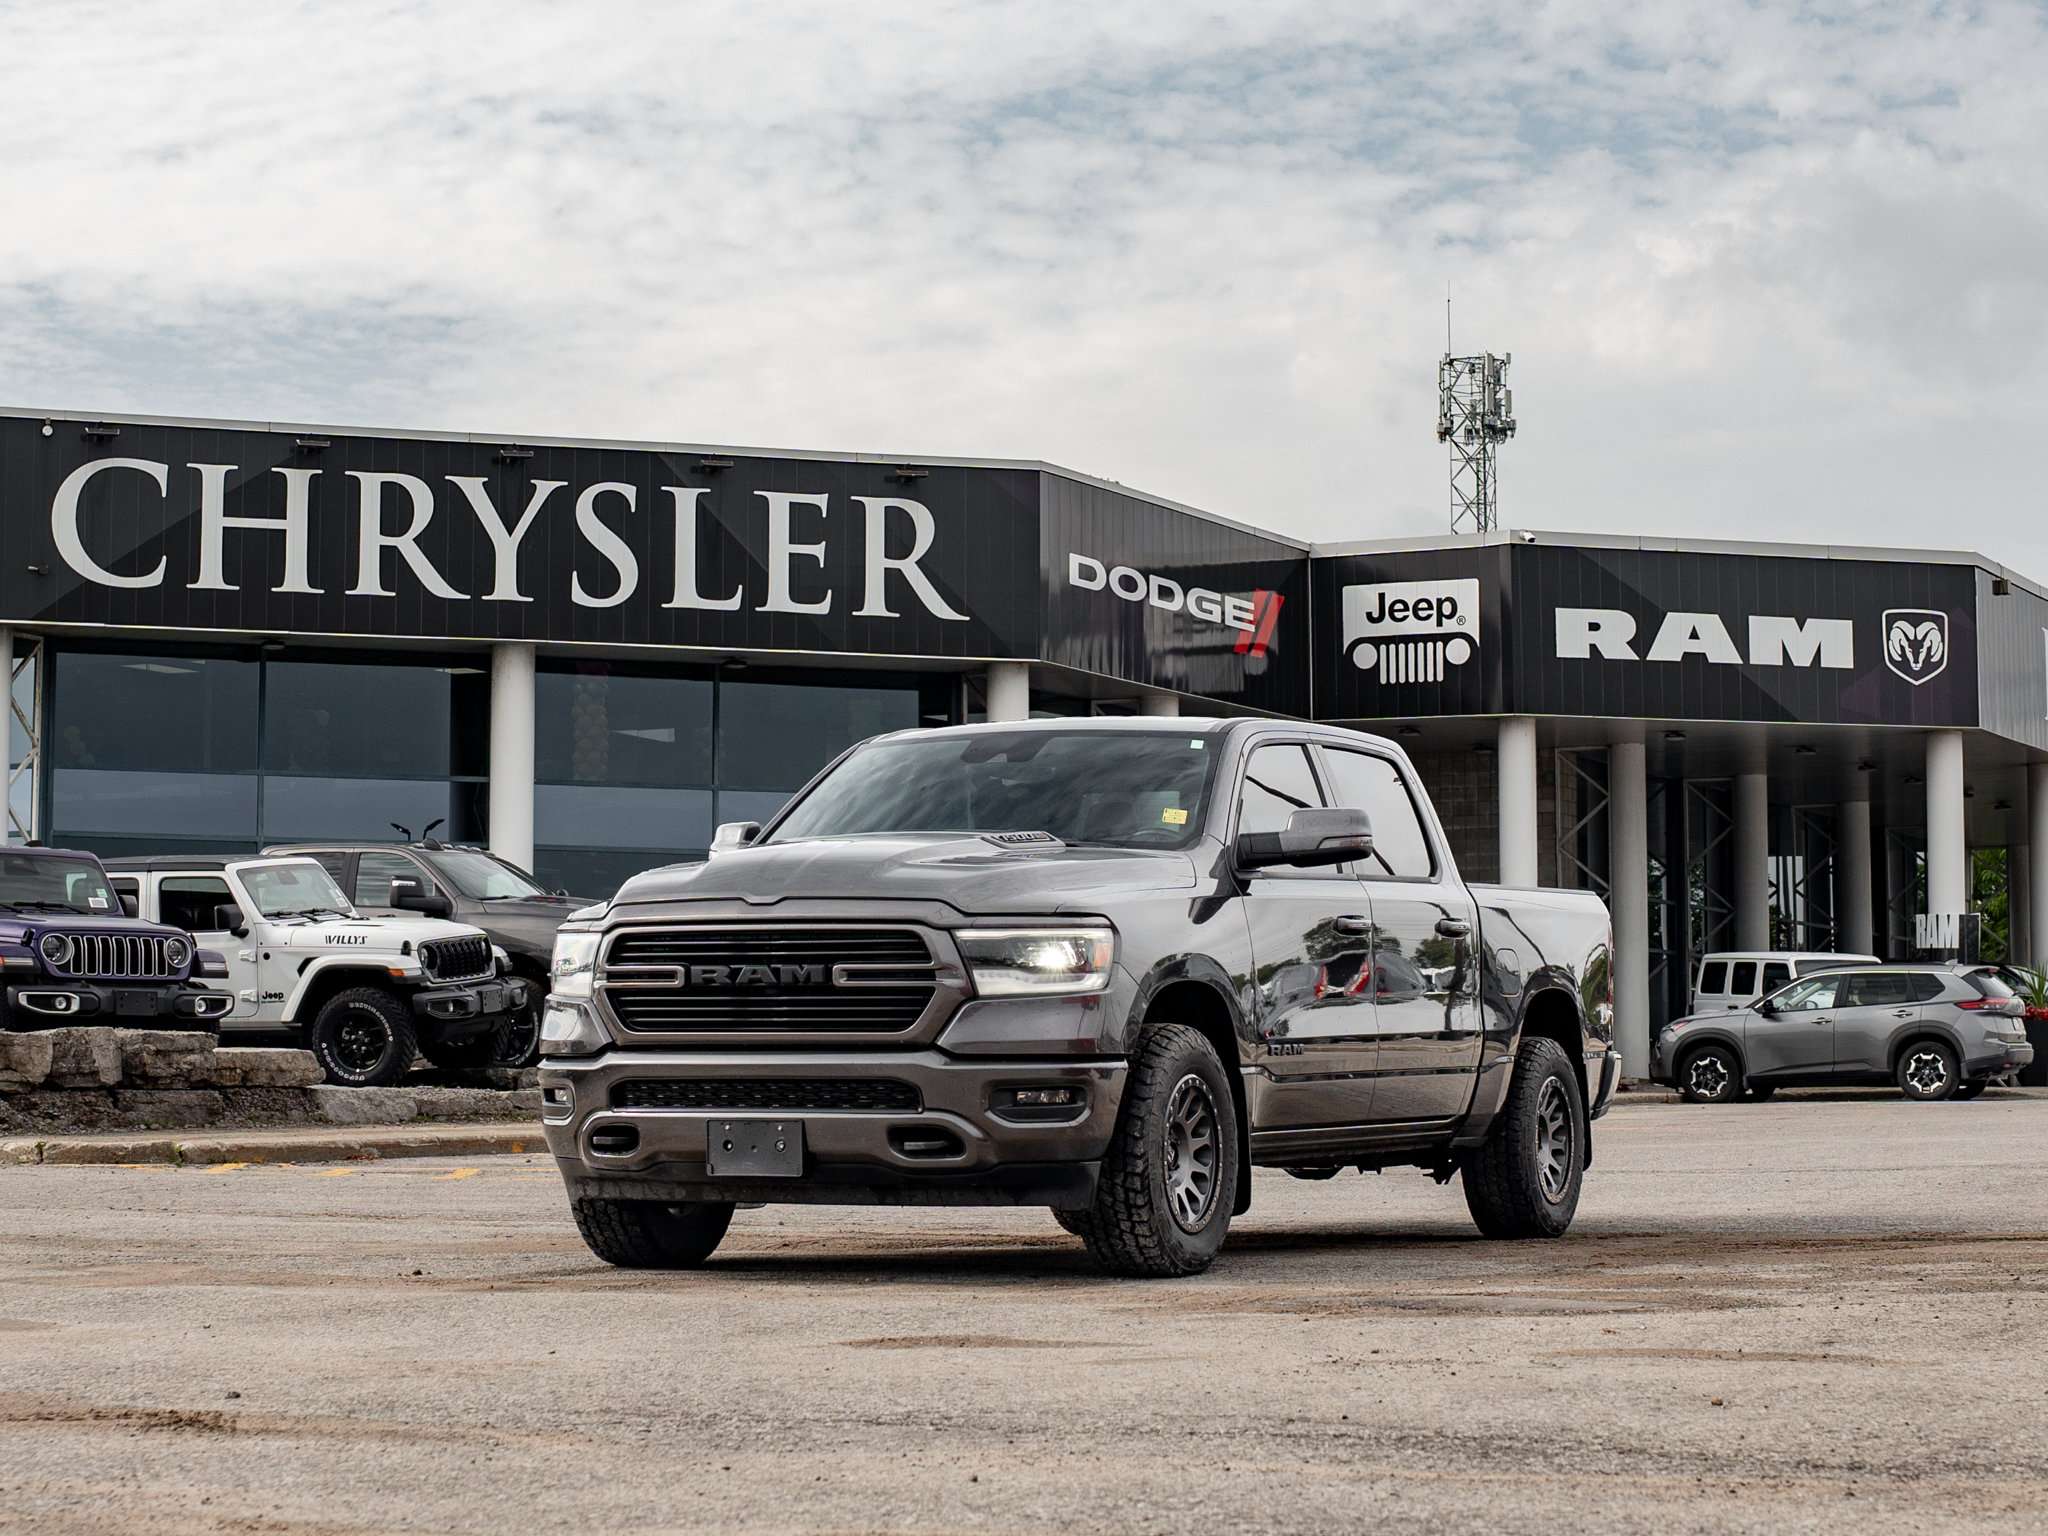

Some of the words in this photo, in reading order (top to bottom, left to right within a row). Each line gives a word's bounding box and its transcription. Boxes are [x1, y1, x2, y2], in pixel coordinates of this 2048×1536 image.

[51, 457, 970, 622] CHRYSLER
[1068, 551, 1257, 633] DODGE
[1555, 607, 1855, 669] RAM
[325, 935, 368, 945] WILLYS
[1915, 913, 1961, 950] RAM
[690, 963, 826, 986] RAM
[262, 990, 284, 1001] Jeep
[1268, 1043, 1305, 1057] RAM
